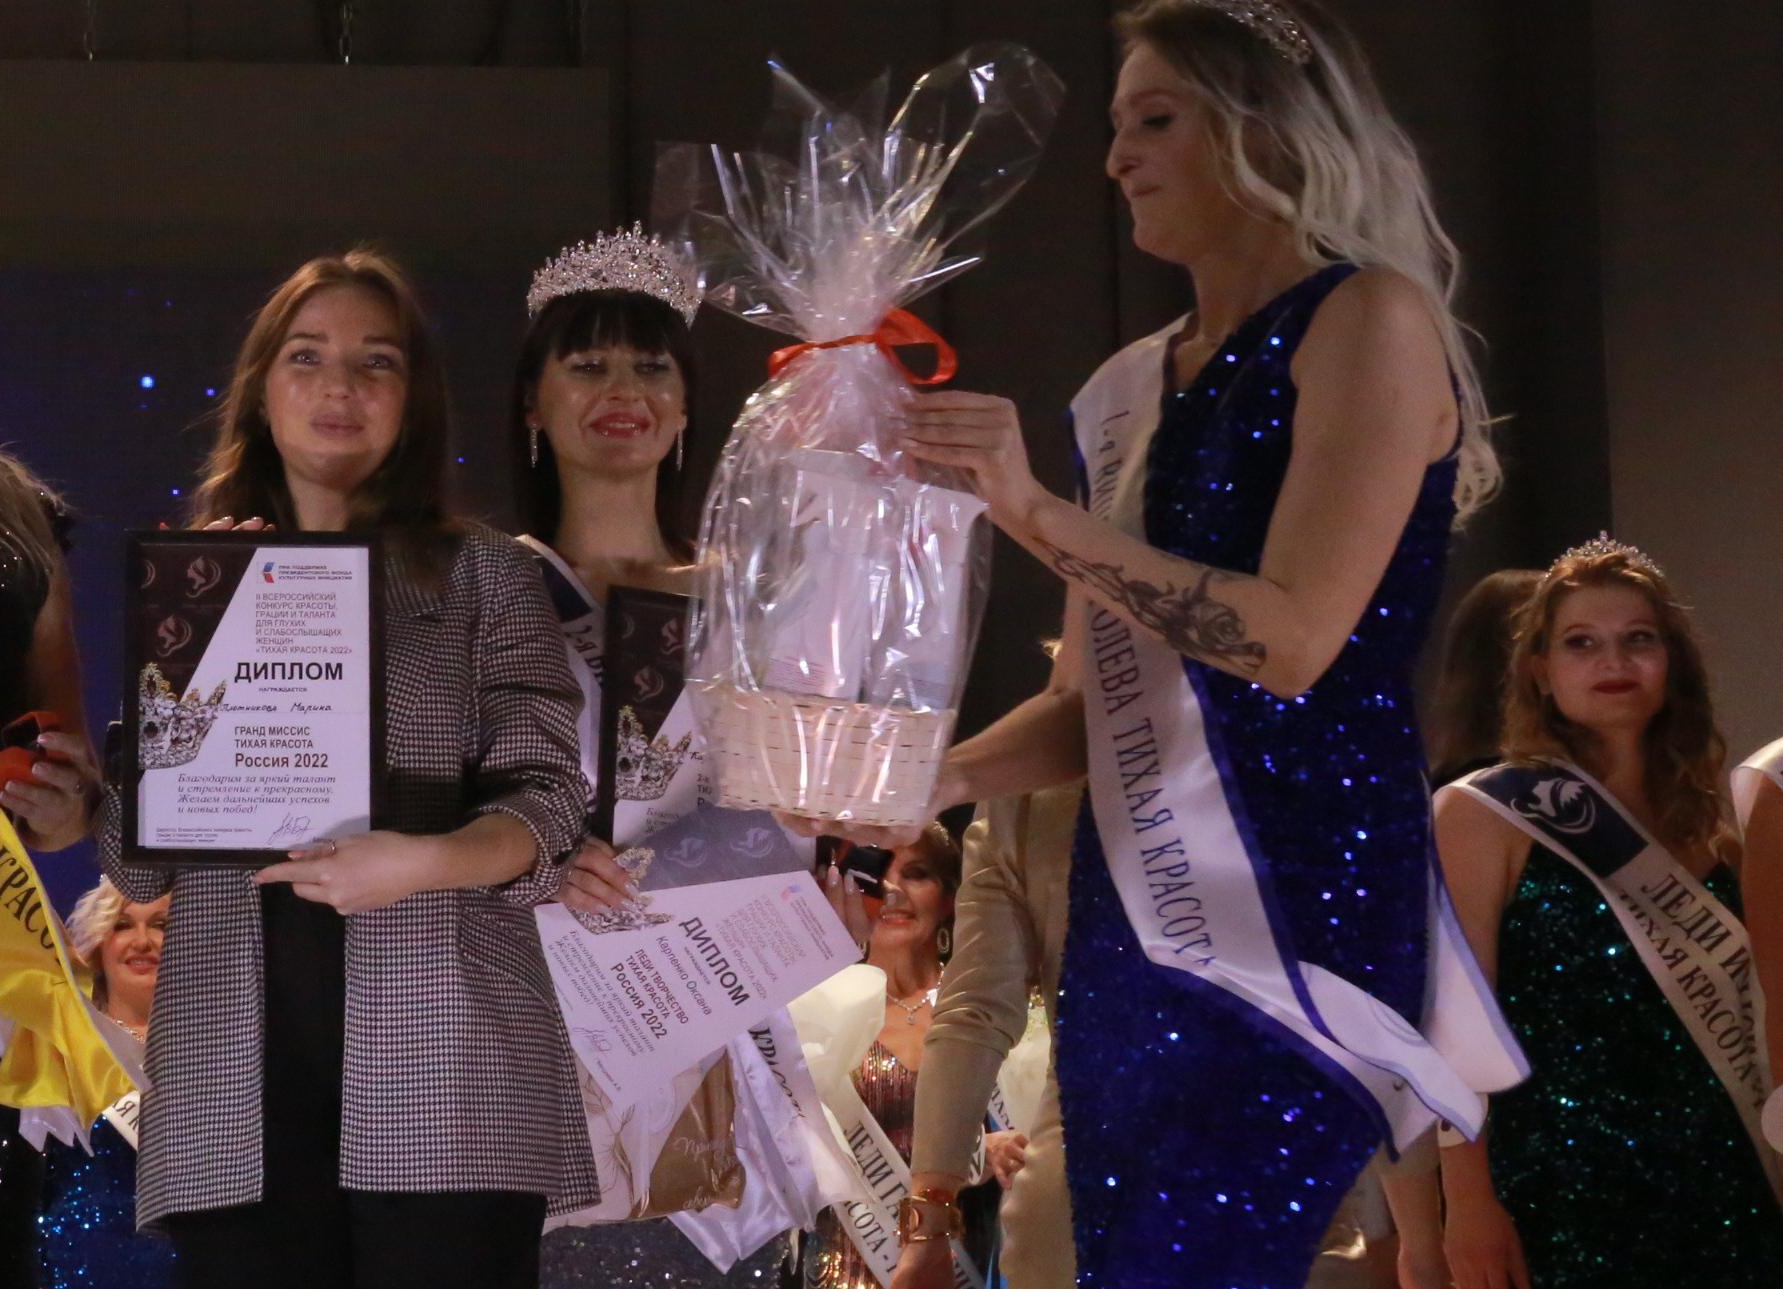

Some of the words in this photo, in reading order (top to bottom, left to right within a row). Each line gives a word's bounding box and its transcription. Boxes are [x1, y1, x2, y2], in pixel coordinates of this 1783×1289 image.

[262, 592, 336, 601] ВСЕРОССИЙСКИЙ
[256, 602, 294, 610] КОНКУРС
[256, 610, 288, 618] ГРАЦИИ
[299, 610, 336, 618] ТАЛАНТА
[256, 620, 273, 628] ДЛЯ
[275, 619, 306, 627] ГЛУХИХ
[256, 628, 262, 636] И
[264, 628, 342, 637] СЛАБОСЛЫШАЩИХ
[256, 637, 294, 646] ЖЕНЩИН
[290, 646, 328, 654] КРАСОТА
[1089, 600, 1143, 717] ОЛЕВА
[234, 662, 343, 684] ДИПЛОМ
[290, 702, 333, 714] Марина
[234, 726, 266, 737] ГРАНД
[269, 726, 310, 736] МИССИС
[234, 739, 267, 749] ТИХАЯ
[270, 739, 314, 749] КРАСОТА
[235, 753, 289, 768] Россия
[294, 753, 329, 768] 2022
[178, 774, 242, 784] Благодарим
[259, 774, 290, 784] яркий
[293, 776, 336, 784] талант
[1112, 717, 1176, 835] ТИХАЯ
[187, 785, 251, 795] стремление
[177, 795, 220, 804] Желаем
[222, 795, 286, 804] дальнейших
[288, 796, 330, 805] успехов
[187, 806, 219, 814] новых
[1641, 873, 1734, 954] ЛЕДИ
[678, 912, 750, 1009] ДИПЛОМ
[655, 934, 690, 982] Карпенко
[684, 978, 714, 1016] Оксана
[625, 954, 648, 983] ТИХАЯ
[642, 981, 671, 1019] КРАСОТА
[634, 947, 654, 973] ЛЕДИ
[649, 970, 689, 1025] ТВОРЧЕСТВО
[609, 962, 647, 1010] Россия
[640, 1006, 668, 1040] 2022
[1677, 965, 1757, 1082] КРАСОТА
[844, 1120, 895, 1190] ЛЕДИ
